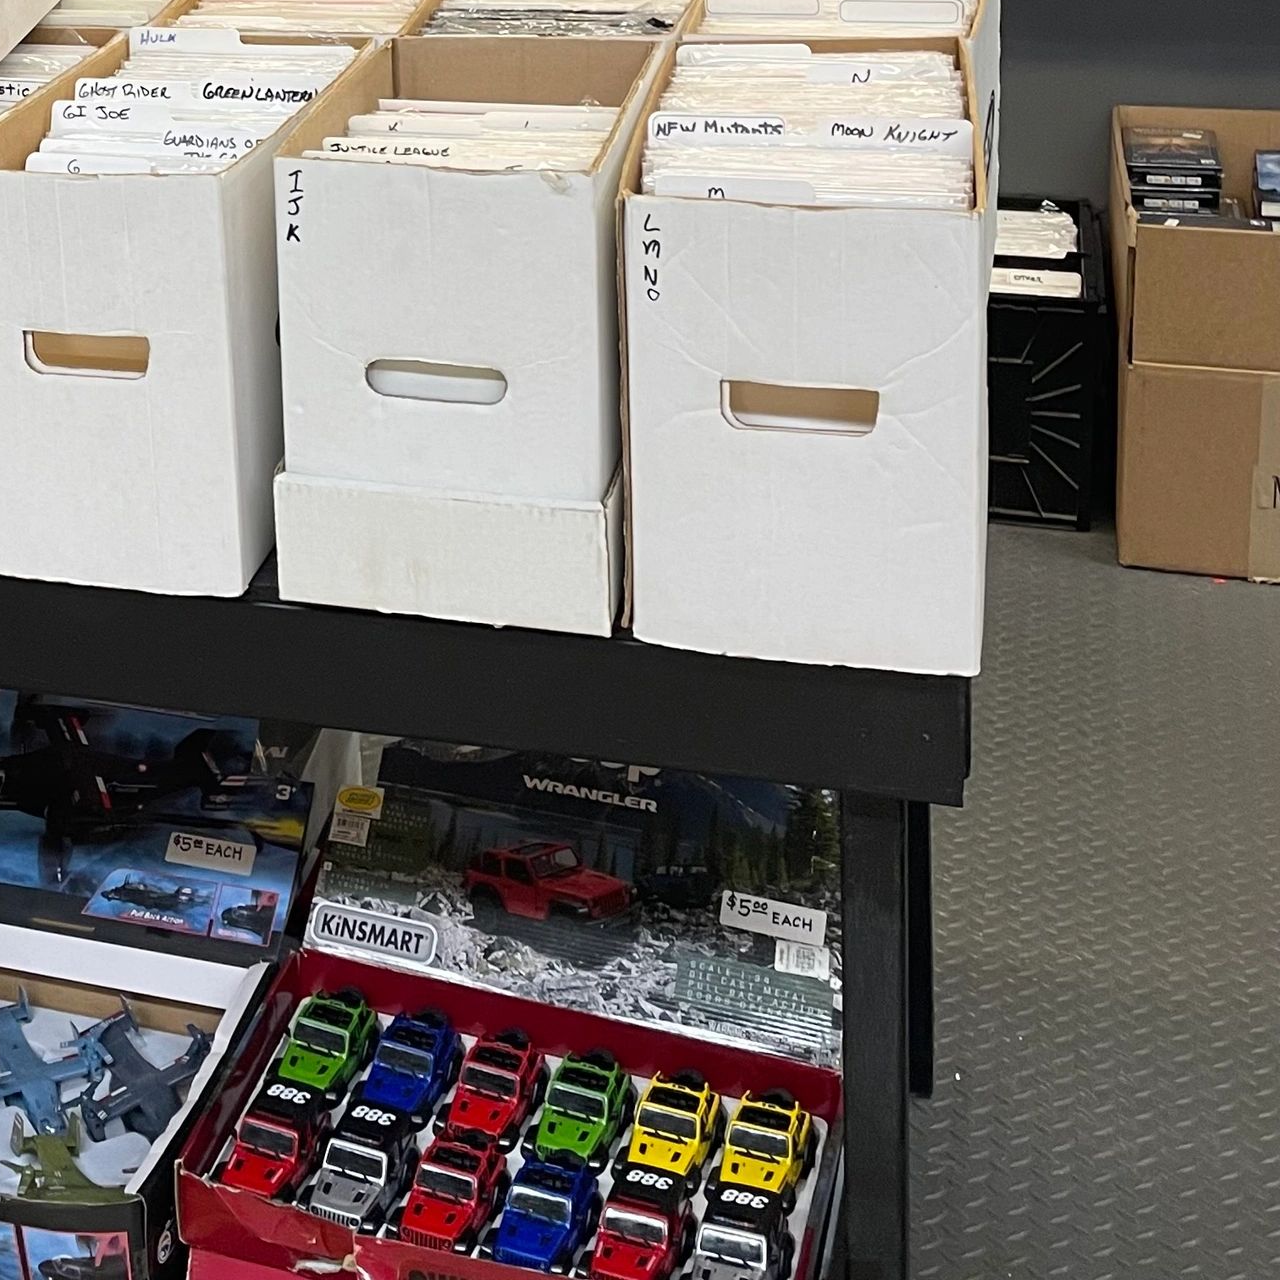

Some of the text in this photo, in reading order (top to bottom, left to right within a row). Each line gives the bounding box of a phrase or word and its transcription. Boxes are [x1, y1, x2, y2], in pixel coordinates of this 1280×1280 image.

[140, 30, 177, 45] HULK
[851, 68, 871, 84] N
[79, 82, 171, 99] GHOST RIDER
[202, 81, 318, 103] GREEN LANTERN
[62, 104, 131, 120] GI JOE
[164, 130, 237, 150] GUARDIANS
[831, 122, 959, 144] MOON KNIGHT
[393, 145, 451, 157] LEAGUE
[287, 170, 304, 193] I
[286, 196, 304, 216] J
[285, 223, 301, 243] K
[643, 214, 661, 232] L
[643, 265, 658, 287] N
[521, 773, 659, 815] WRANGLER
[205, 842, 244, 862] EACH
[130, 909, 184, 925] Pull Back Action
[772, 911, 813, 933] EACH
[320, 912, 426, 956] KiNSMART
[689, 959, 731, 977] SCALE
[688, 970, 808, 1004] DIE CAST METAL
[687, 979, 828, 1017] PULL BACK ACTION
[266, 1083, 312, 1105] 388
[351, 1105, 397, 1126] 388
[625, 1169, 674, 1190] 388
[720, 1188, 770, 1209] 388
